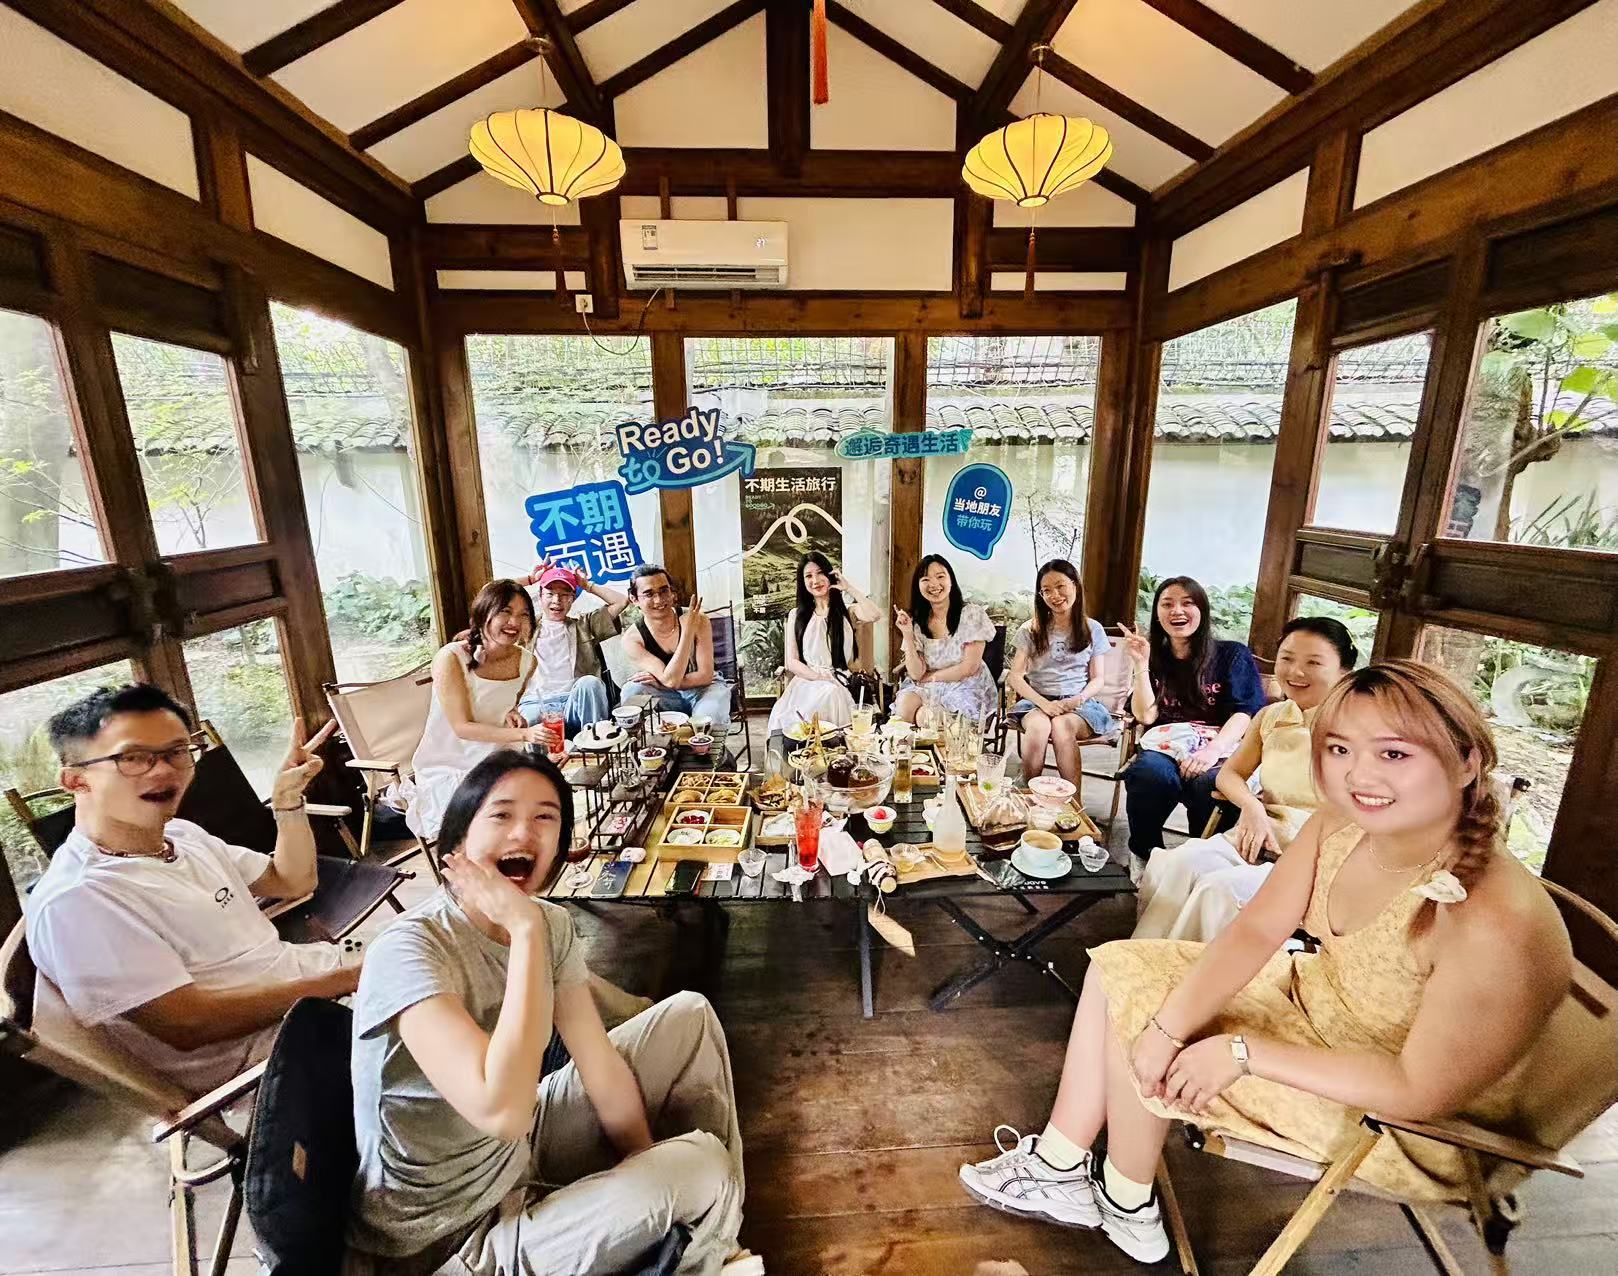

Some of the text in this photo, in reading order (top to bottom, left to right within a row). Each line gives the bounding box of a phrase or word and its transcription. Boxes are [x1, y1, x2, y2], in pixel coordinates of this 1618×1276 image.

[619, 410, 718, 454] Ready
[844, 430, 958, 456] 邂逅奇遇生活
[621, 440, 725, 484] to Go!
[744, 477, 837, 493] 不期生活旅行
[973, 486, 988, 499] @
[533, 488, 625, 541] 不期
[953, 497, 1002, 518] 当地朋友
[956, 514, 993, 532] 带你玩
